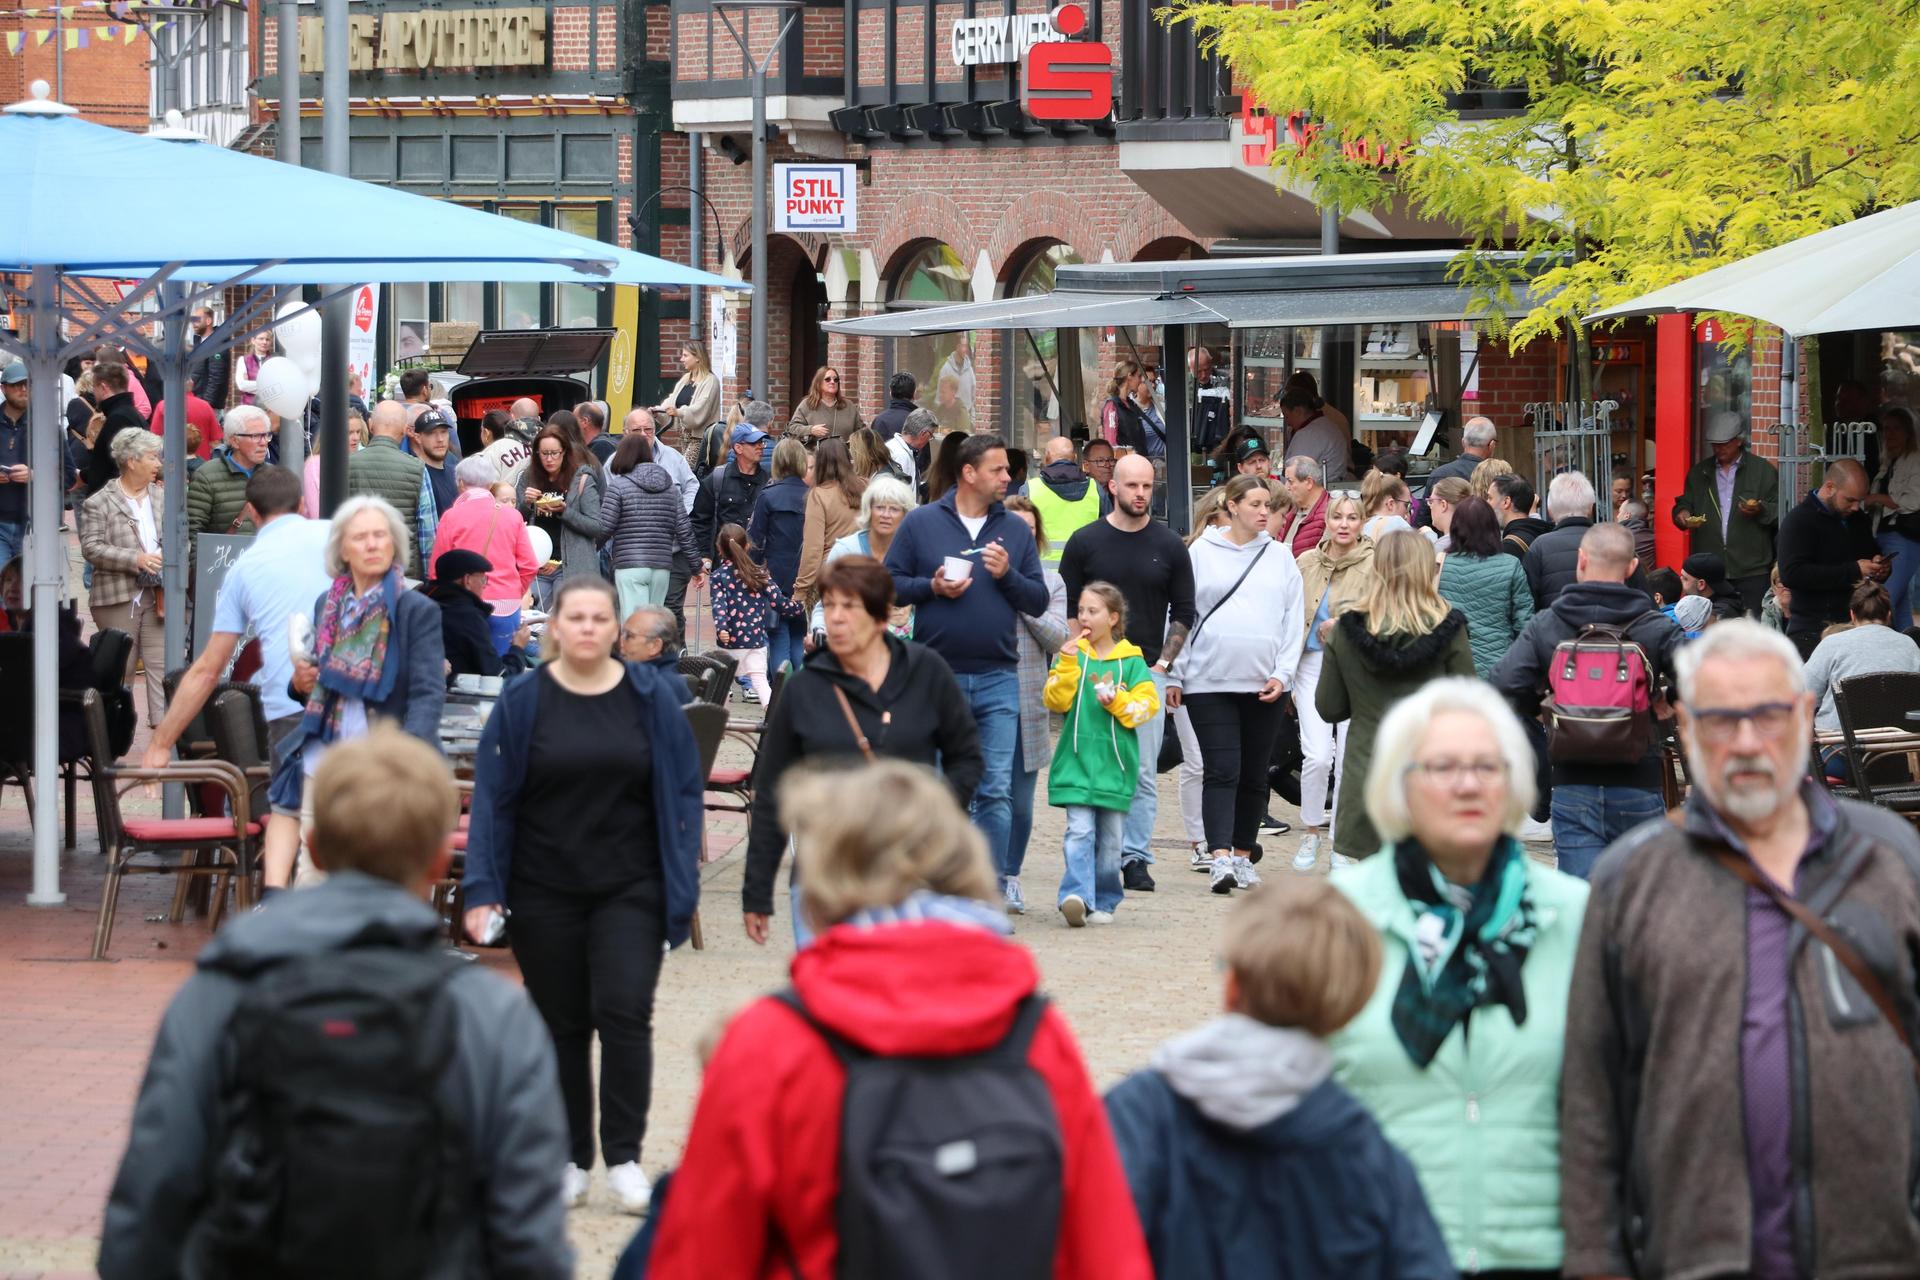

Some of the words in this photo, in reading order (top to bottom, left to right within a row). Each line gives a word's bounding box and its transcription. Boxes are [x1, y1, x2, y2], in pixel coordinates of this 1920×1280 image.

[377, 8, 545, 68] APOTHEKE
[952, 15, 1009, 66] GERRY
[792, 178, 839, 198] STIL
[786, 199, 845, 215] PUNKT
